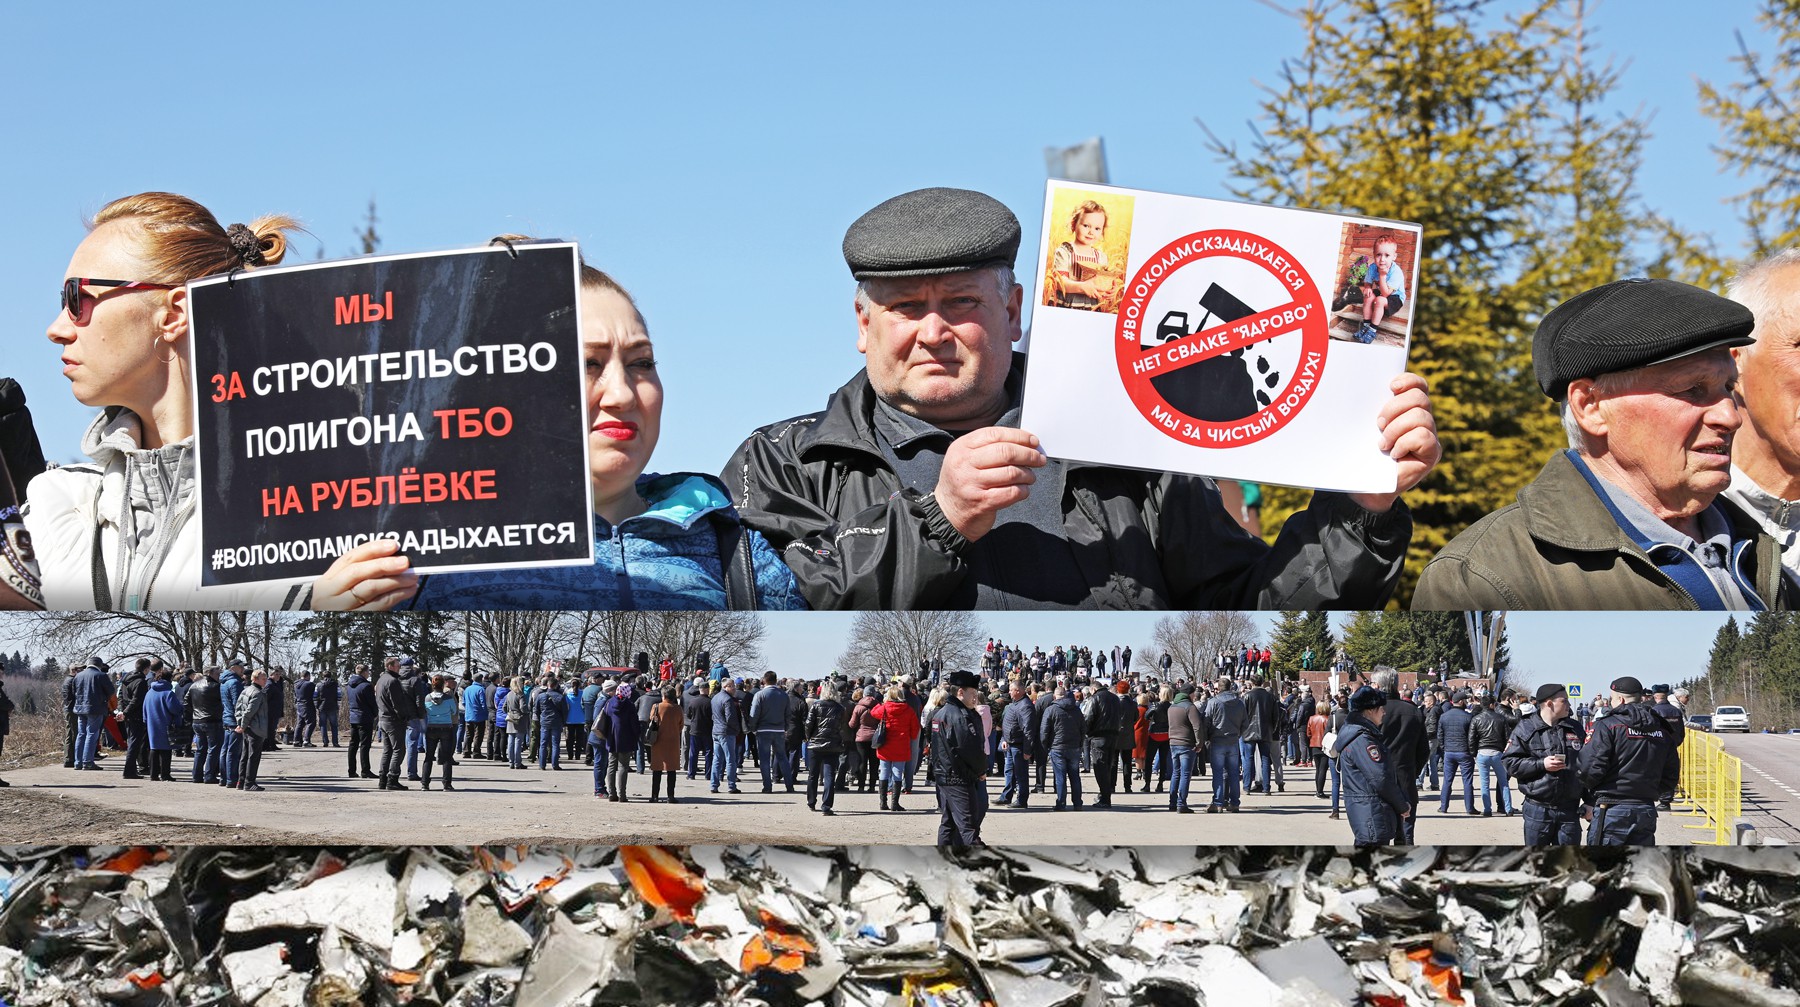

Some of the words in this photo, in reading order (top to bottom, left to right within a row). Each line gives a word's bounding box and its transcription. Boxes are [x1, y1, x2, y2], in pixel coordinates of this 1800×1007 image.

[335, 291, 393, 326] МЫ
[1122, 236, 1305, 341] #ВОЛОКОЛАМСКЗАДЫХАЕТСЯ
[1133, 353, 1161, 375] НЕТ
[1167, 332, 1231, 363] СВАЛКЕ
[1233, 303, 1314, 339] "ЯДРОВО"
[211, 372, 247, 403] ЗА
[252, 341, 557, 397] СТРОИТЕЛЬСТВО
[1150, 405, 1178, 432] МЫ
[1182, 422, 1202, 441] ЗА
[1207, 411, 1278, 442] ЧИСТЫЙ
[1277, 351, 1322, 418] ВОЗДУХ!
[245, 413, 425, 459] ПОЛИГОНА
[434, 406, 513, 439] ТБО
[262, 485, 304, 517] НА
[311, 468, 498, 512] РУБЛЁВКЕ
